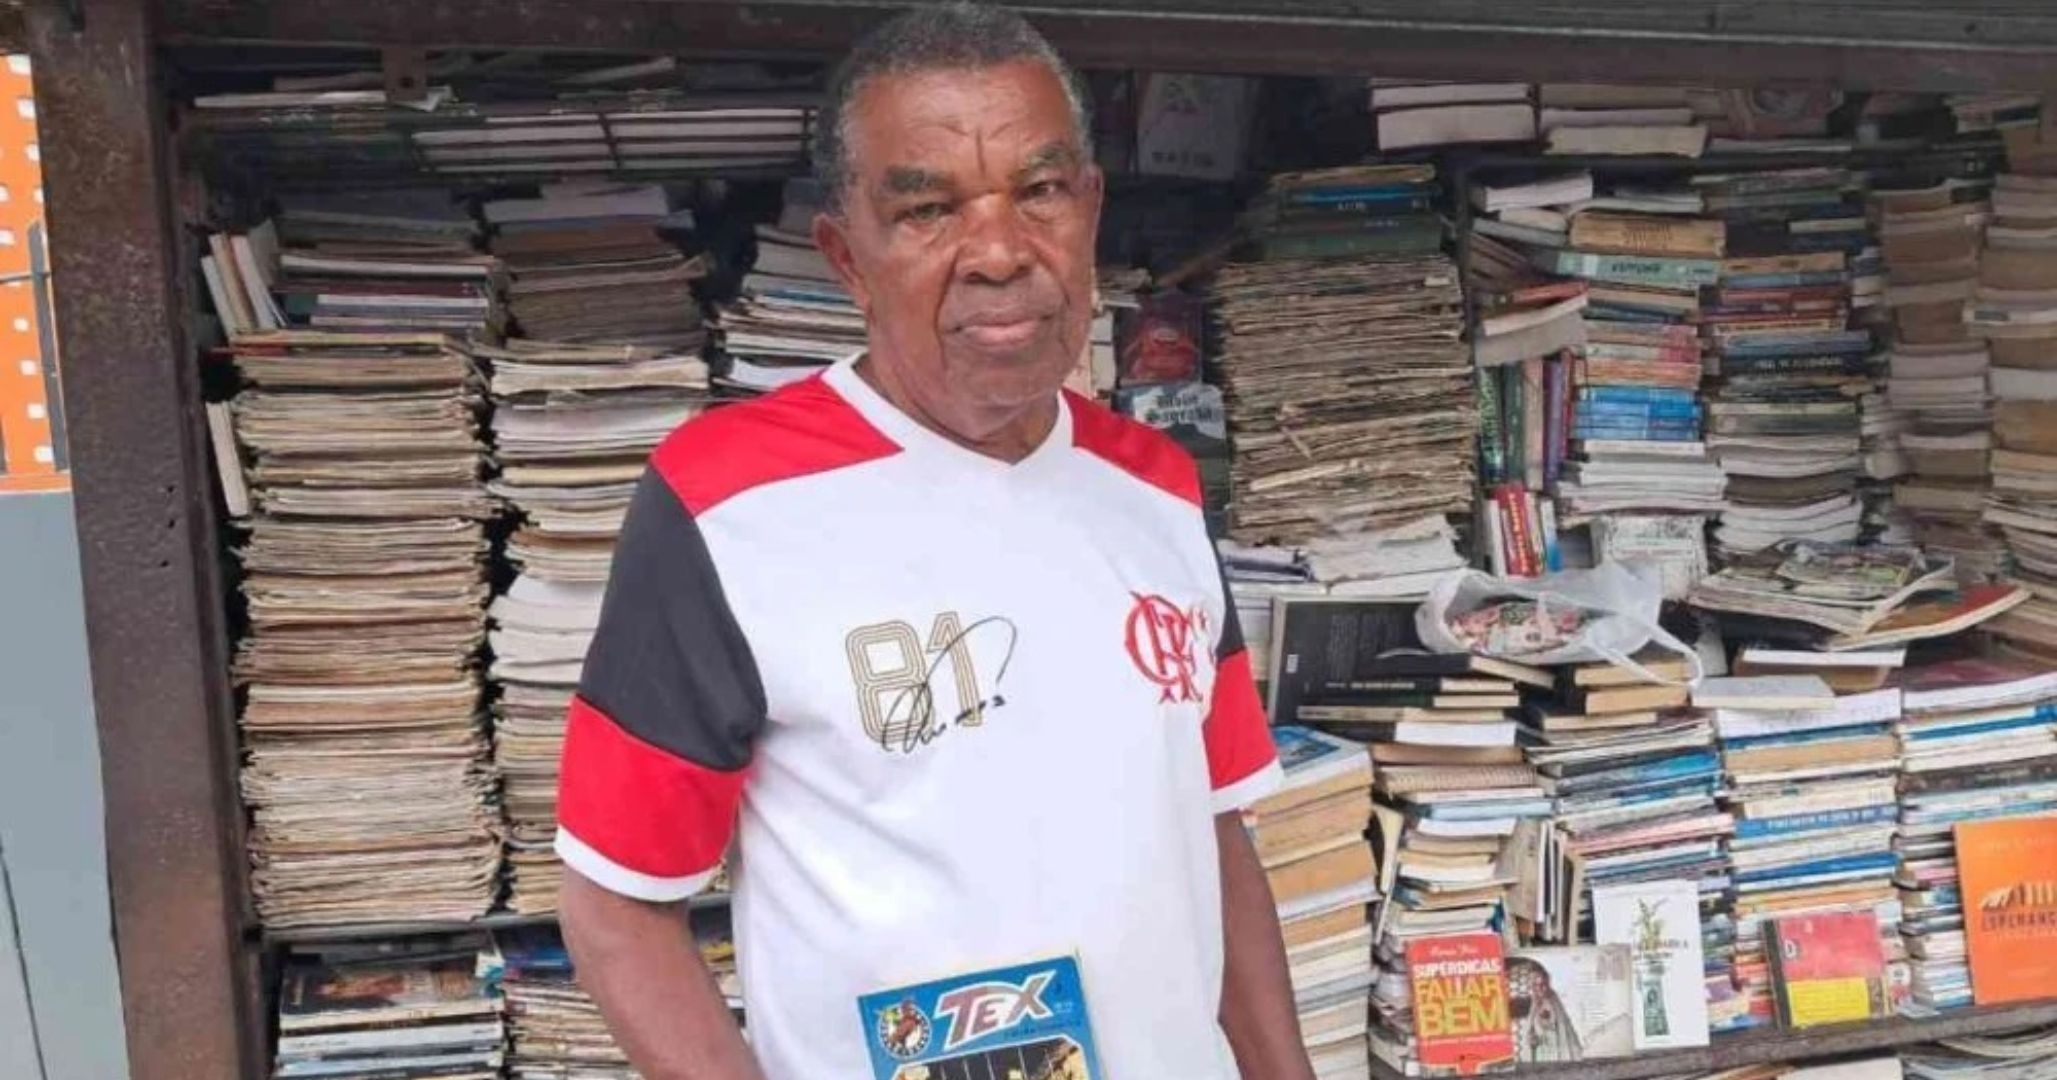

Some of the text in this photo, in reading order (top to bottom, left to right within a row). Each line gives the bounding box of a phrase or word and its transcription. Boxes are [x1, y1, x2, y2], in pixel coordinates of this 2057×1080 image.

[845, 611, 983, 743] 81
[1412, 959, 1501, 978] SUPERDICAS
[934, 970, 1056, 1049] TEX
[1418, 996, 1508, 1037] BEM
